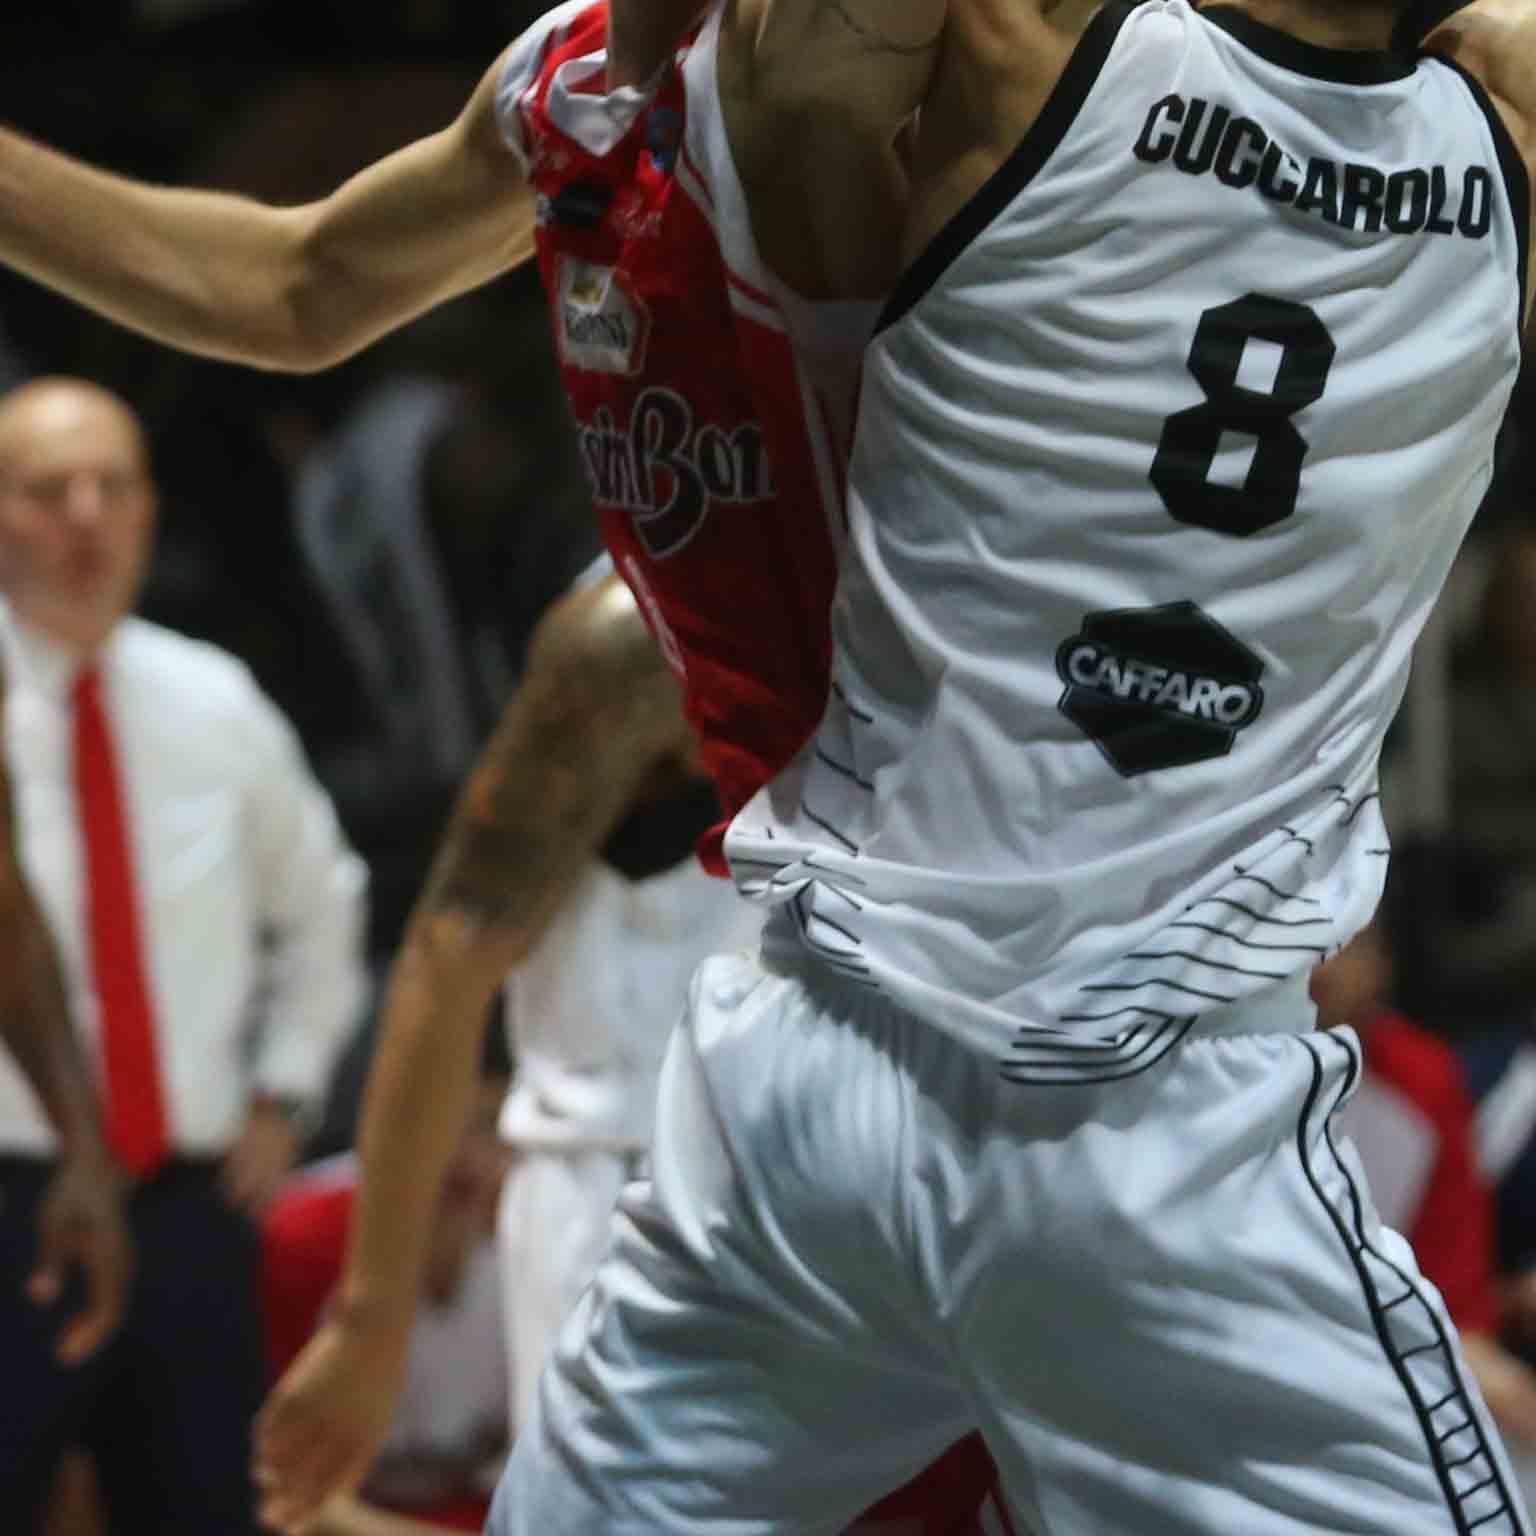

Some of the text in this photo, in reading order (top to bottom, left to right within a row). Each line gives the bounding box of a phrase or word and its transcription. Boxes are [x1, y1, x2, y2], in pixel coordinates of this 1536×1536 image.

[1133, 94, 1495, 239] CUCCAROLO
[1149, 293, 1336, 535] 8
[1069, 645, 1254, 727] CAFFARO
